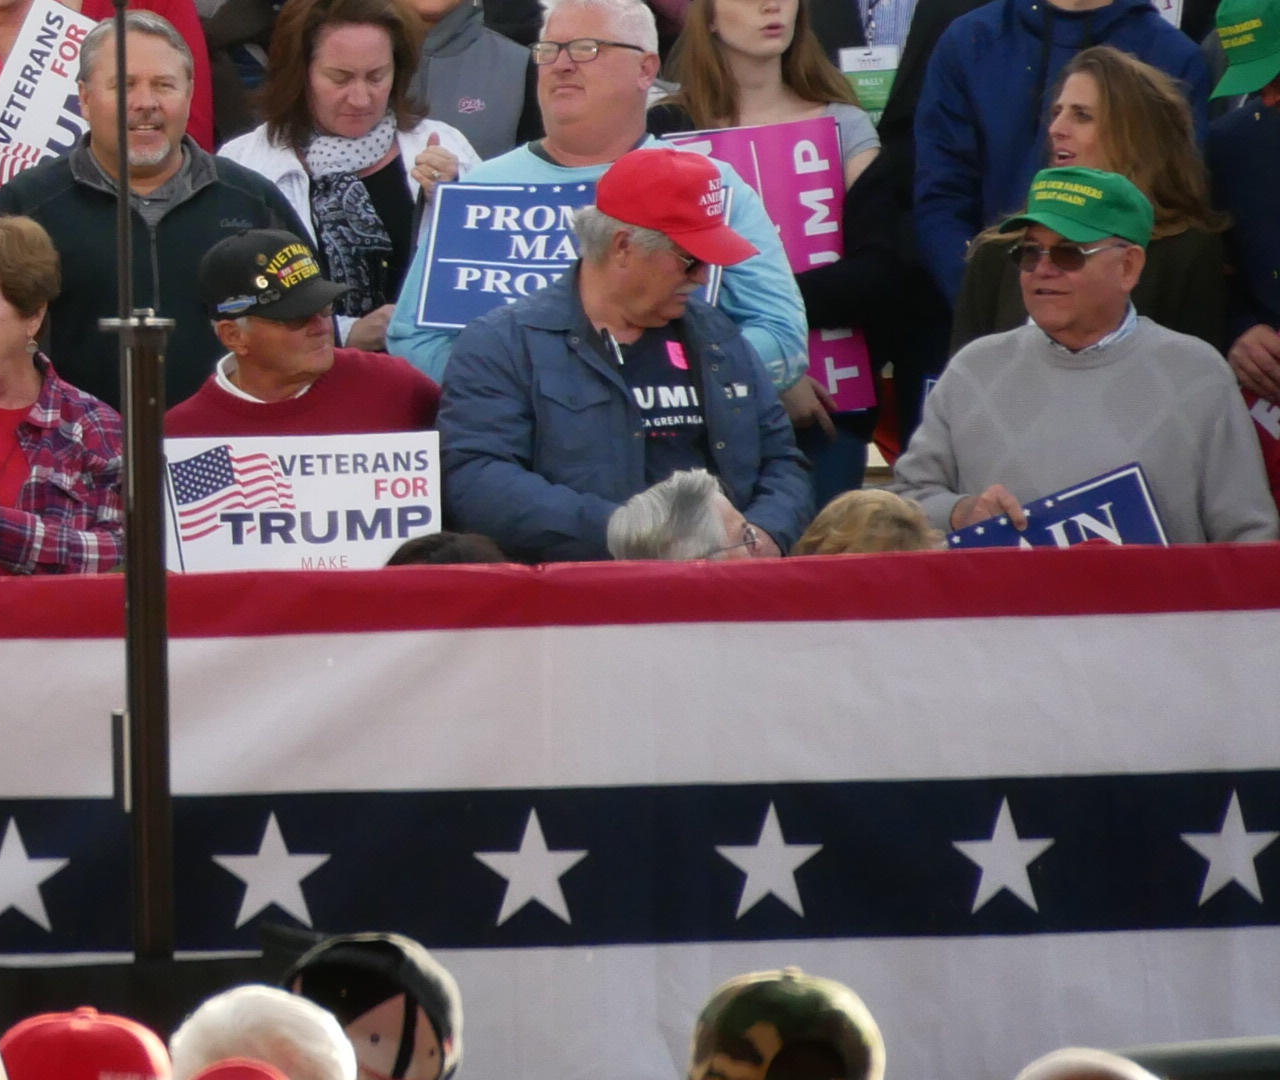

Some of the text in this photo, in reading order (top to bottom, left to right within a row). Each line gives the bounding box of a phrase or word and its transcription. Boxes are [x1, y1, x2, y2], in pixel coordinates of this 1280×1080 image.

[50, 23, 88, 79] FOR
[858, 77, 884, 87] RALLY
[1064, 182, 1103, 199] FARMERS
[266, 243, 312, 276] VIETNAM
[508, 235, 580, 260] MA
[280, 261, 320, 288] VETERAN
[653, 416, 684, 427] GREAT
[686, 415, 703, 425] AGA
[278, 450, 429, 477] VETERANS
[373, 477, 428, 501] FOR
[220, 504, 432, 546] TRUMP
[301, 555, 348, 570] MAKE
